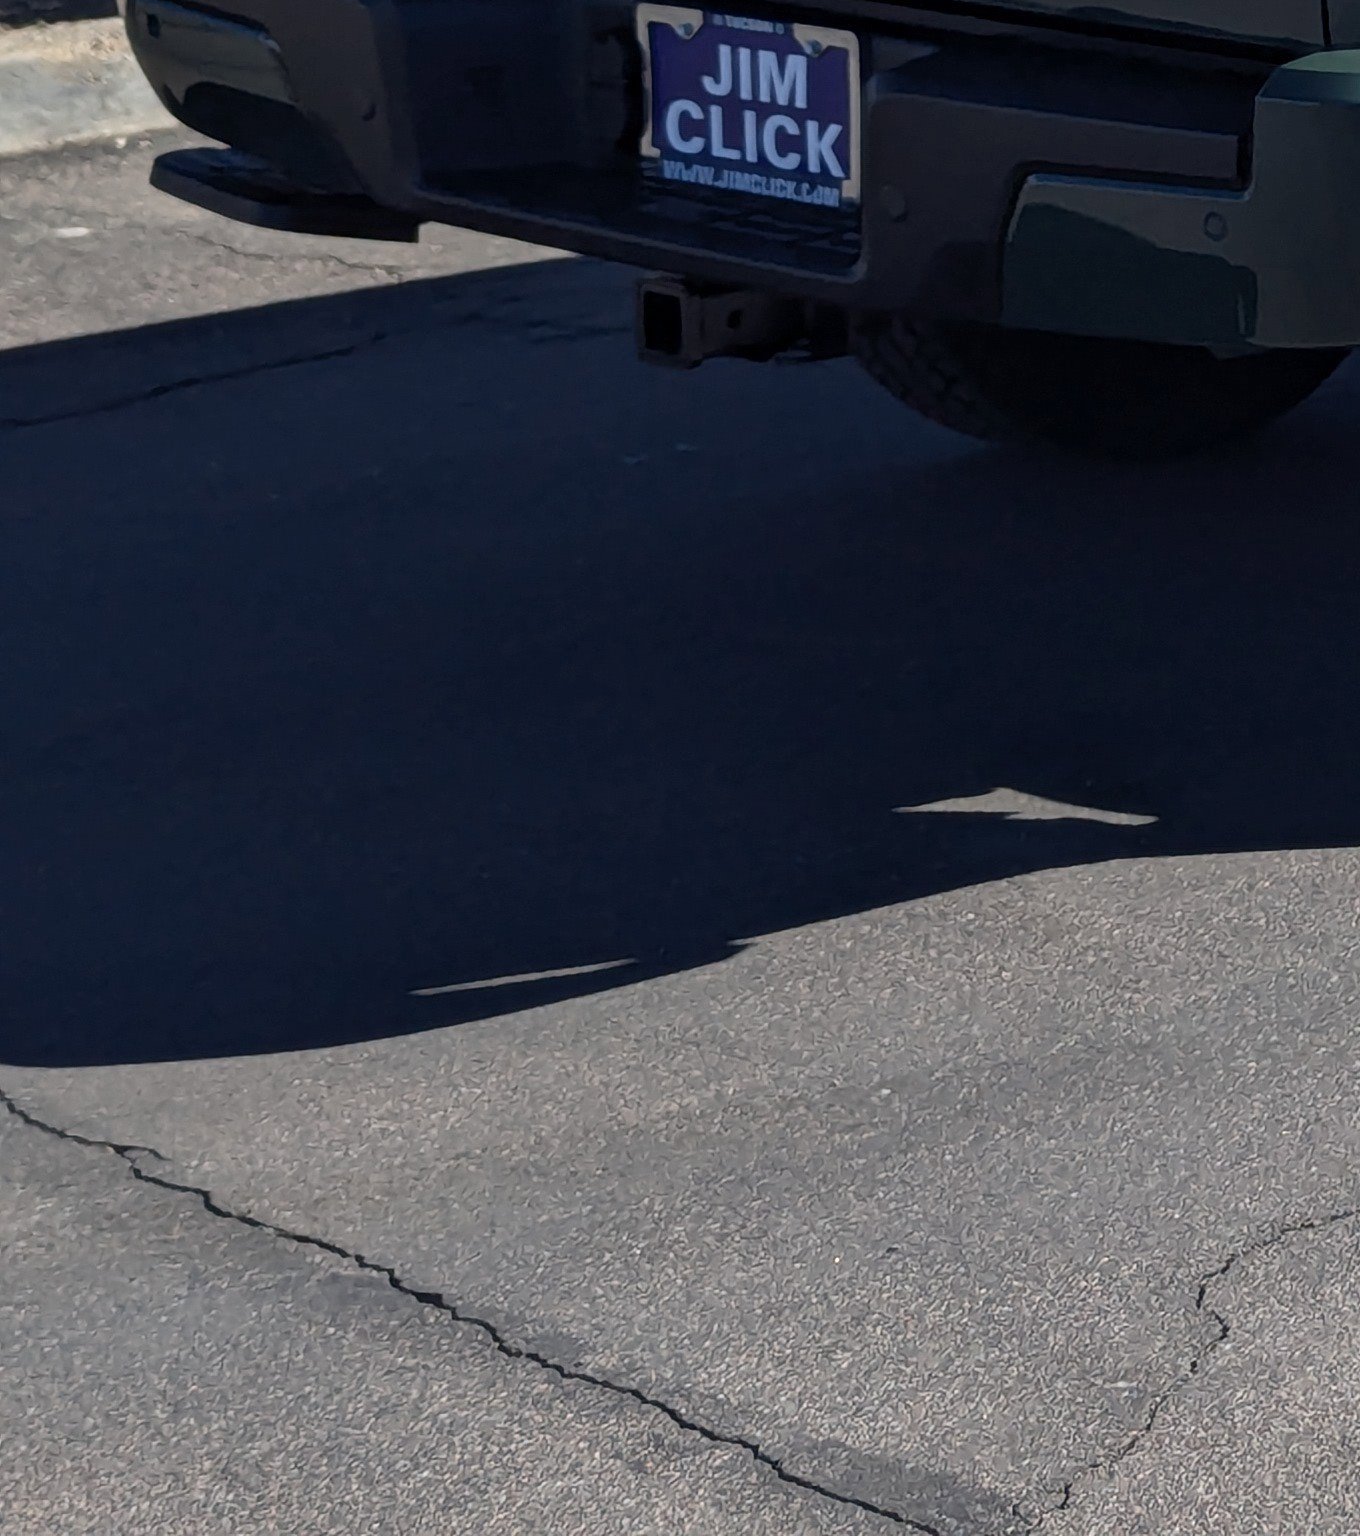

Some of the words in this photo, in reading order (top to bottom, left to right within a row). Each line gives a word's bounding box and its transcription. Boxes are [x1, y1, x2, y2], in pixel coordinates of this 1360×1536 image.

[701, 43, 808, 109] JIM
[665, 99, 846, 178] CLICK
[661, 159, 841, 208] WWW.JIMCLICK.COM
